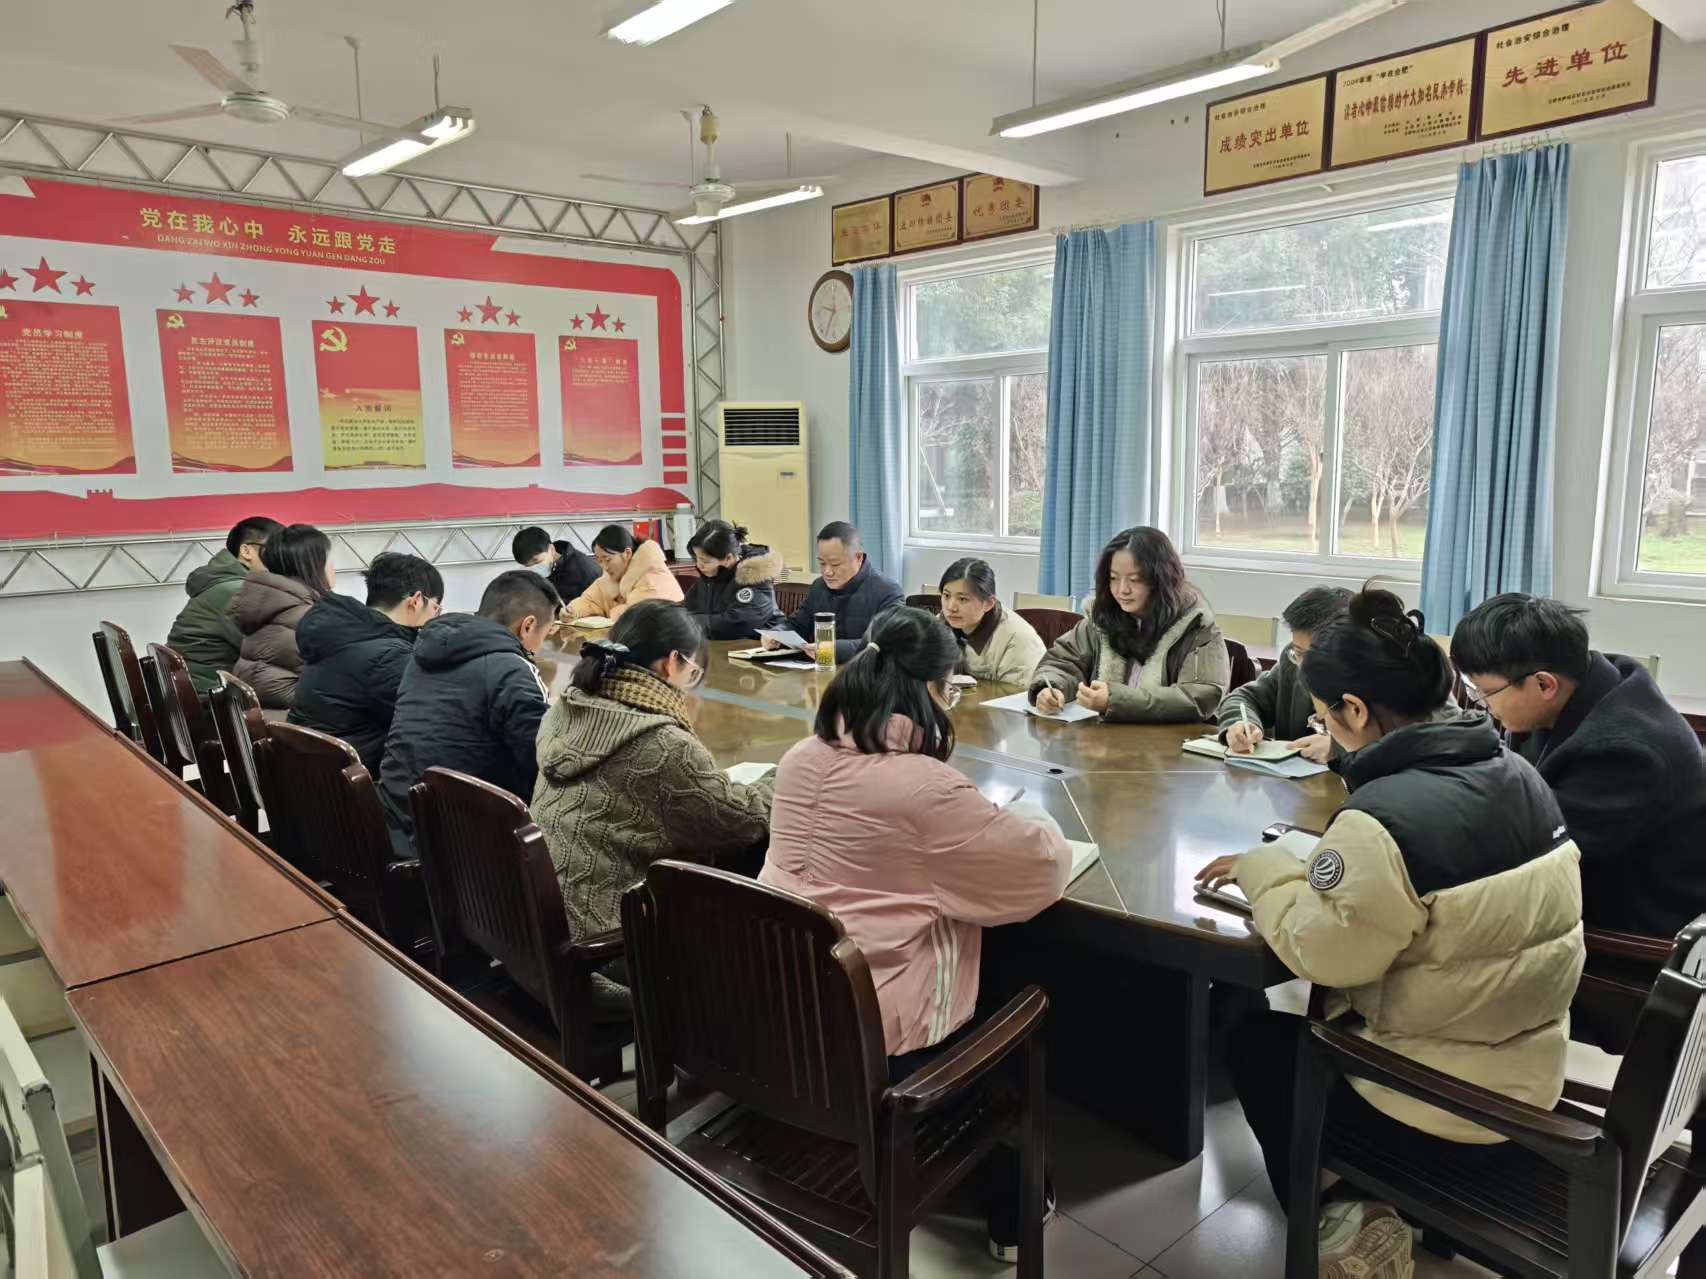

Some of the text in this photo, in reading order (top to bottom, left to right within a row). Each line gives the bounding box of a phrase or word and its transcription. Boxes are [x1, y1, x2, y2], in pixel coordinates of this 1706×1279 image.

[1502, 41, 1629, 88] 先进单位
[1220, 120, 1310, 153] 成绩突出单位
[140, 207, 396, 254] 党在我心中 永远跟党走
[157, 234, 185, 245] DANG
[223, 240, 238, 249] XIN
[240, 242, 272, 253] ZHONG
[275, 247, 299, 256] YONG
[301, 249, 324, 259] YUAN
[326, 252, 341, 260] GEN
[343, 254, 367, 263] DANG
[368, 257, 385, 265] ZOU
